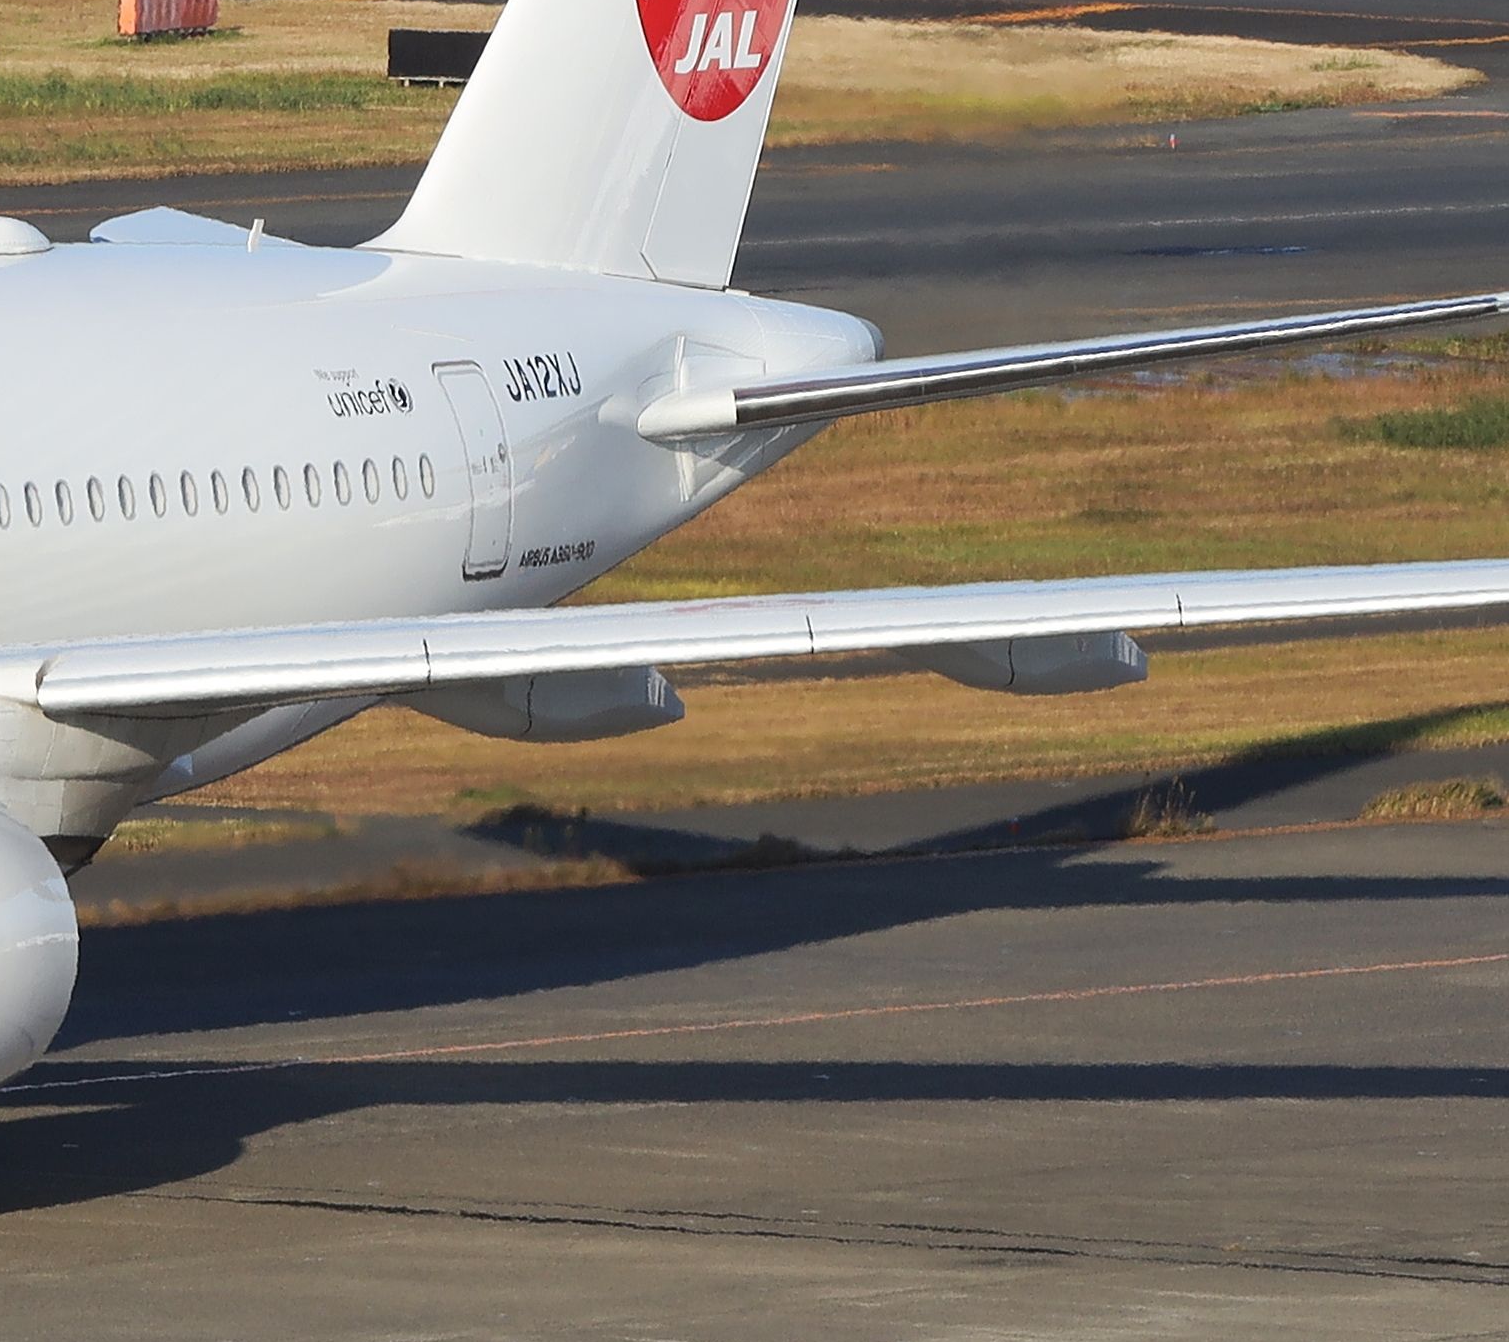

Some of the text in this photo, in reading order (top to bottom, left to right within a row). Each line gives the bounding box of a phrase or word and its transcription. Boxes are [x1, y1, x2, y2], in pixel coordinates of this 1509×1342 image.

[674, 10, 762, 75] JAL
[327, 379, 392, 418] unicef
[502, 351, 583, 403] JA12XJ
